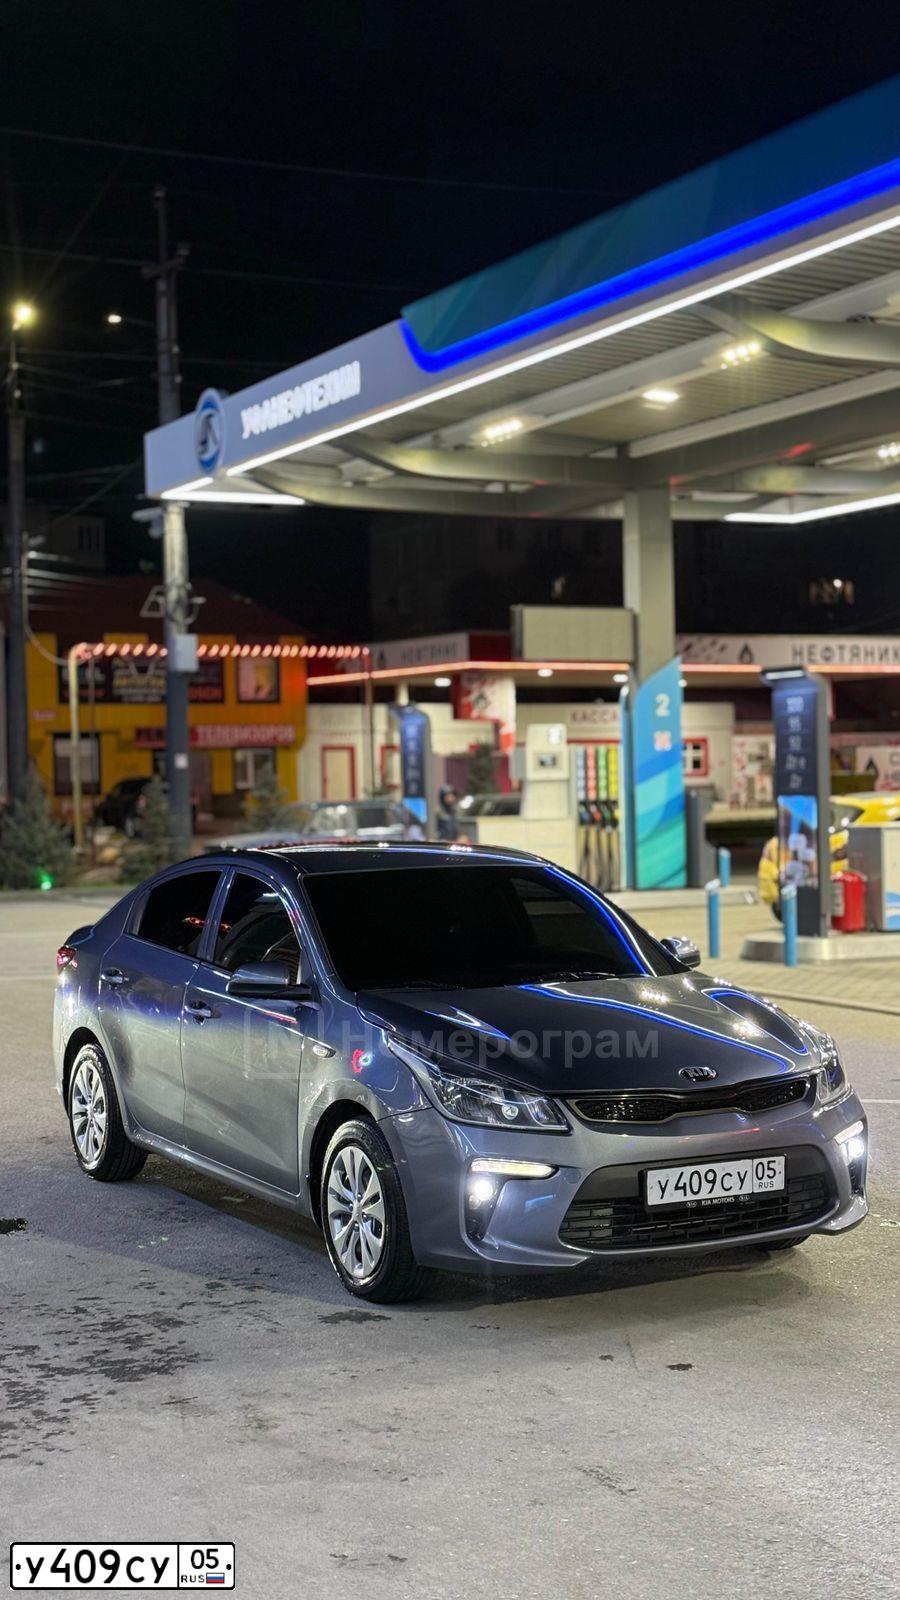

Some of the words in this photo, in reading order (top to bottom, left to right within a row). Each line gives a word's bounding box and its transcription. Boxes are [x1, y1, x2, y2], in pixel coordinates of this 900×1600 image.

[655, 693, 671, 717] 2
[658, 1168, 748, 1199] У409СУ
[755, 1160, 776, 1181] 05
[758, 1180, 774, 1189] RUS
[712, 1197, 735, 1205] MOTORS
